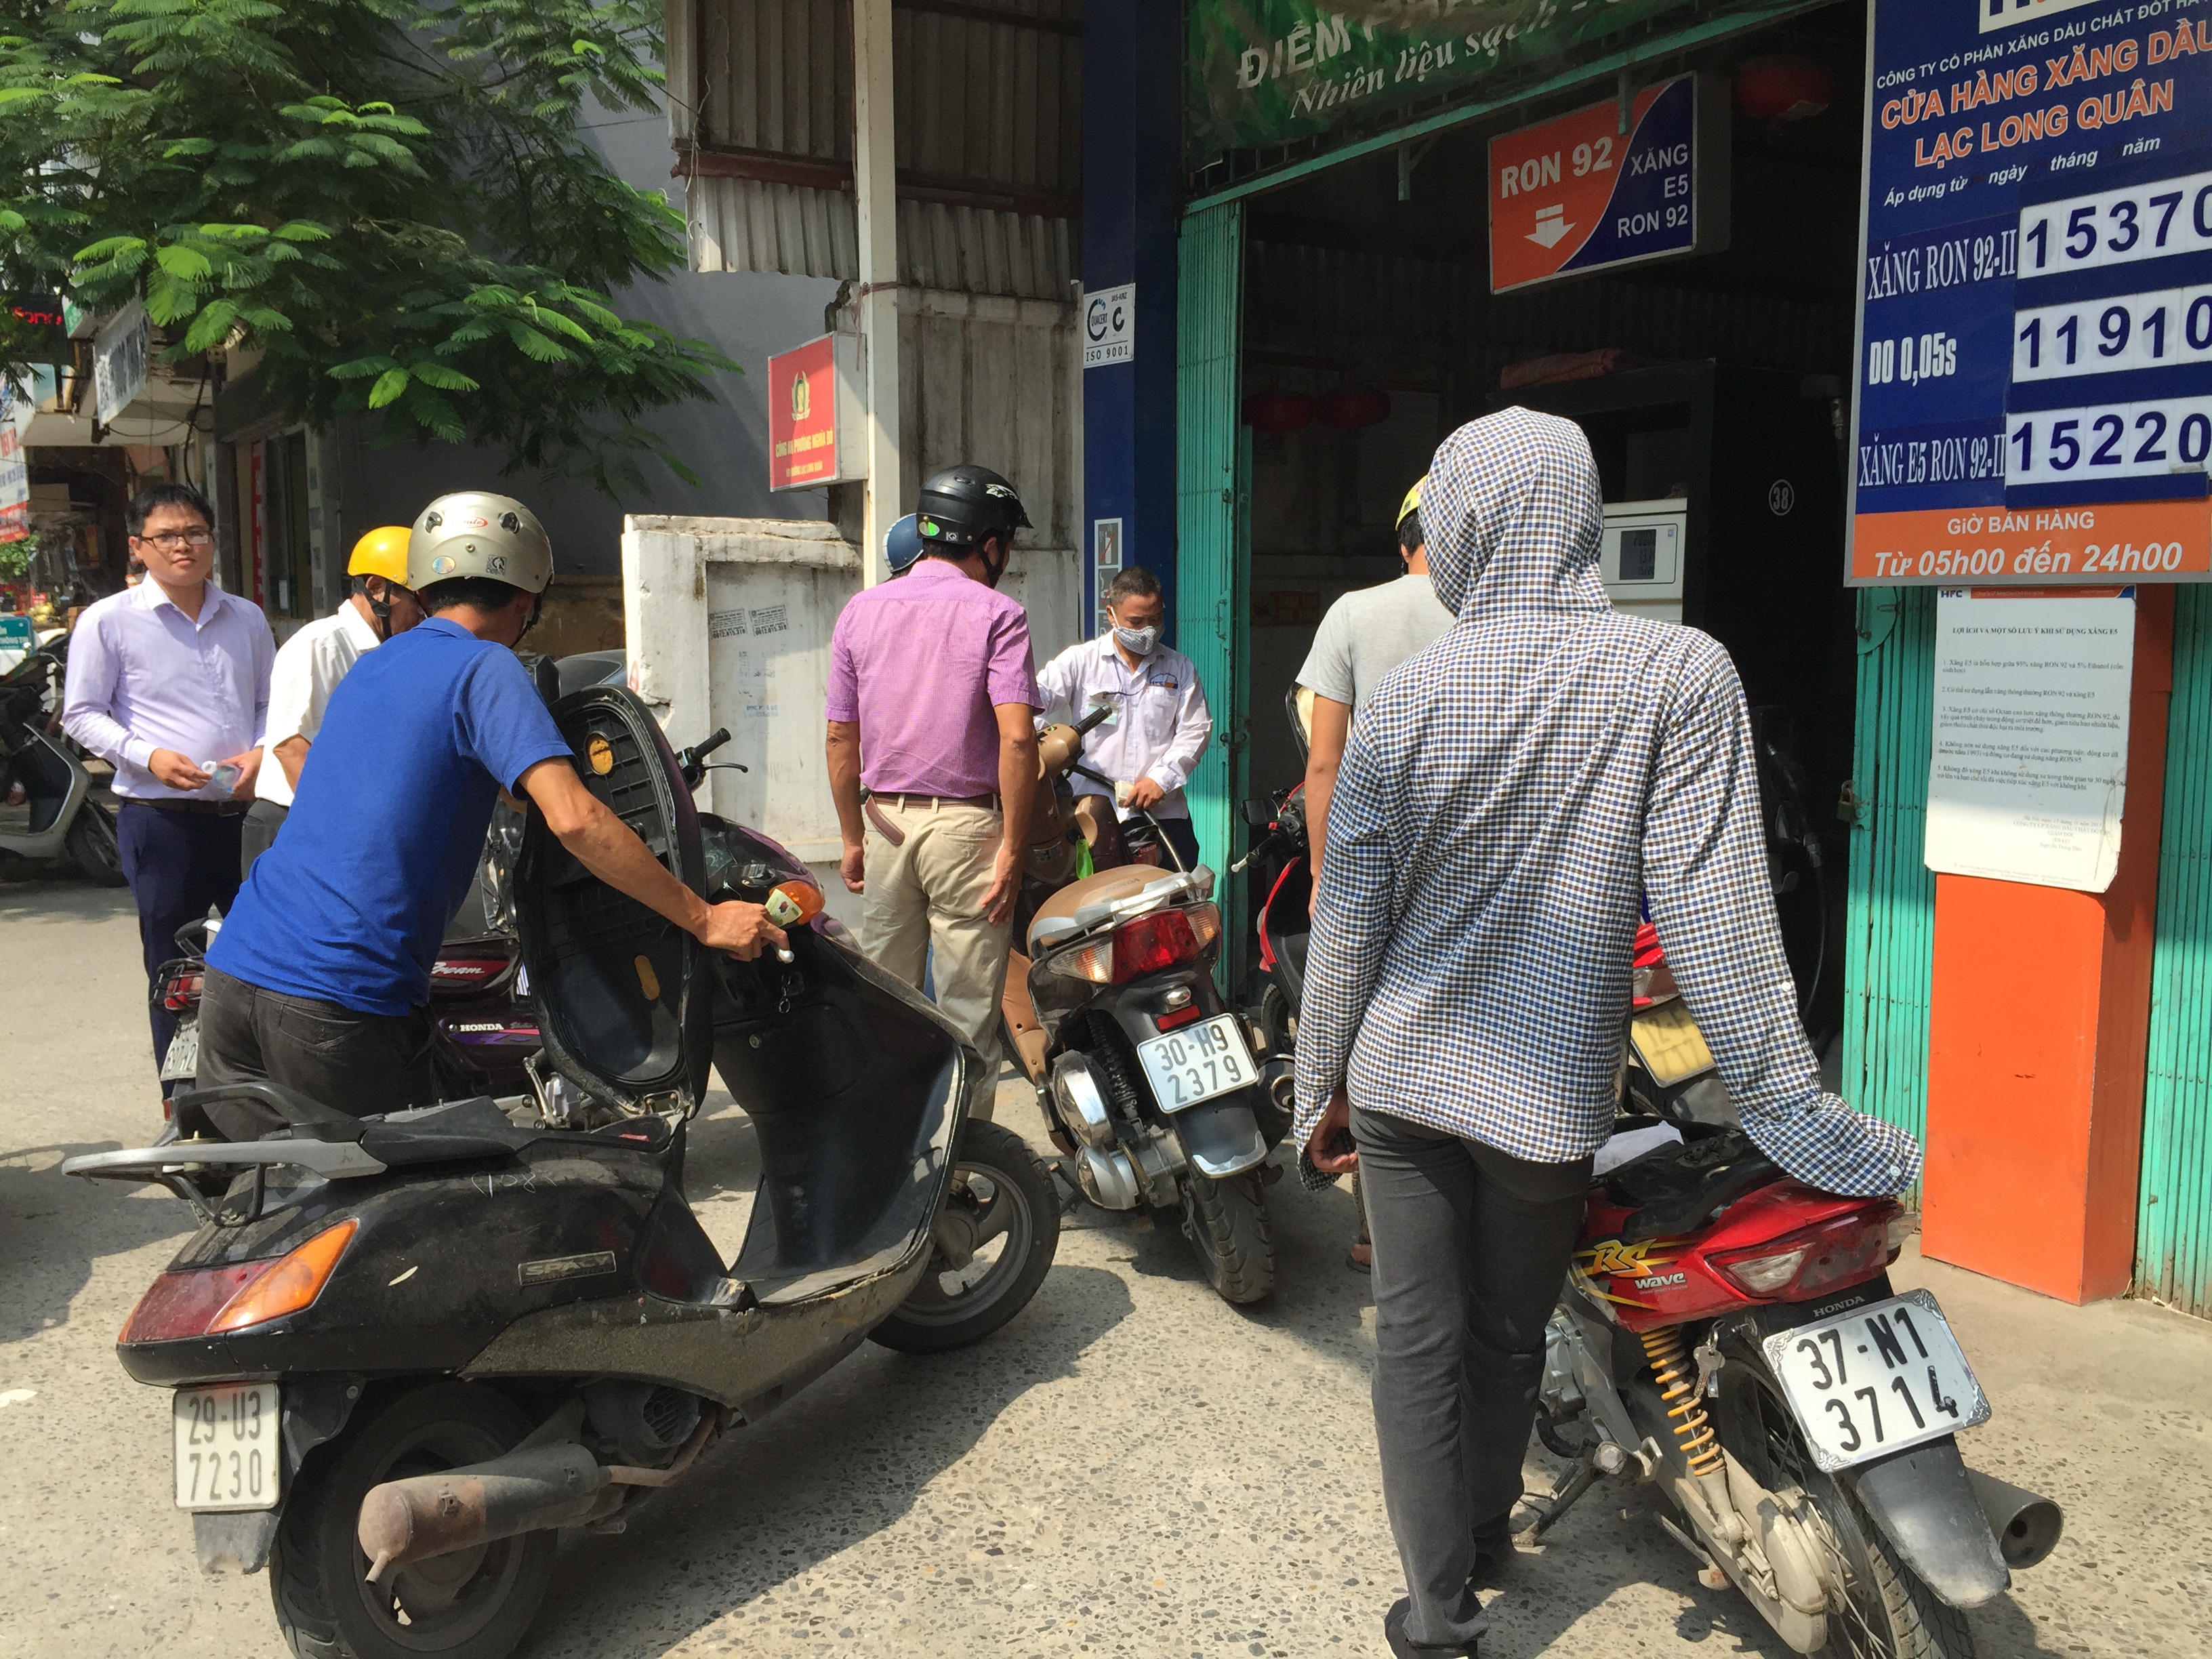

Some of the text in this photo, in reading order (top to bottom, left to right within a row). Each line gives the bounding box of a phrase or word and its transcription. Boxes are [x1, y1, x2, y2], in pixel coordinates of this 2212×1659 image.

[1235, 12, 1351, 89] ĐIỂM
[1289, 66, 1385, 120] Nhiên
[1395, 37, 1456, 82] liệu
[1465, 0, 1557, 57] sạch
[1877, 68, 1916, 89] CÔNG
[1919, 62, 1937, 78] TY
[2007, 32, 2049, 54] XĂNG
[1881, 88, 1944, 129] CỬA
[1951, 65, 2038, 114] HÀNG
[2044, 39, 2139, 90] XĂNG
[1914, 78, 2174, 169] LẠC LONG QUÂN
[1501, 136, 1613, 199] RON 92
[1631, 143, 1688, 177] XĂNG
[1664, 173, 1688, 198] E5
[1908, 180, 1946, 201] dụng
[1988, 163, 2028, 185] ngày
[2050, 150, 2097, 171] tháng
[2122, 137, 2160, 157] năm
[1618, 204, 1688, 238] RON 92
[2026, 184, 2212, 269] 15370
[1867, 241, 1920, 300] XĂNG
[1926, 239, 1969, 291] RON
[1086, 346, 1128, 361] ISO 9001
[2019, 295, 2212, 369] 11910
[1868, 340, 1894, 385] DO
[1858, 434, 1904, 487] XĂNG
[1906, 442, 1927, 482] E5
[1931, 437, 1967, 482] RON
[2011, 411, 2211, 472] 15220
[1773, 487, 1789, 510] 38
[1988, 511, 2030, 533] BÁN
[2036, 508, 2095, 531] HÀNG
[1875, 539, 2183, 577] Từ 05h00 đến 24h00
[1940, 590, 1963, 598] HFC
[460, 1023, 504, 1032] HONDA
[1154, 1024, 1229, 1071] 30-H9
[1167, 1055, 1242, 1104] 2379
[525, 1256, 610, 1276] SPACY
[1814, 1295, 1865, 1317] HONDA
[1797, 1307, 1929, 1390] 37-N1
[189, 1391, 261, 1445] 29-U3
[1825, 1365, 1959, 1452] 3714
[189, 1448, 262, 1501] 7230
